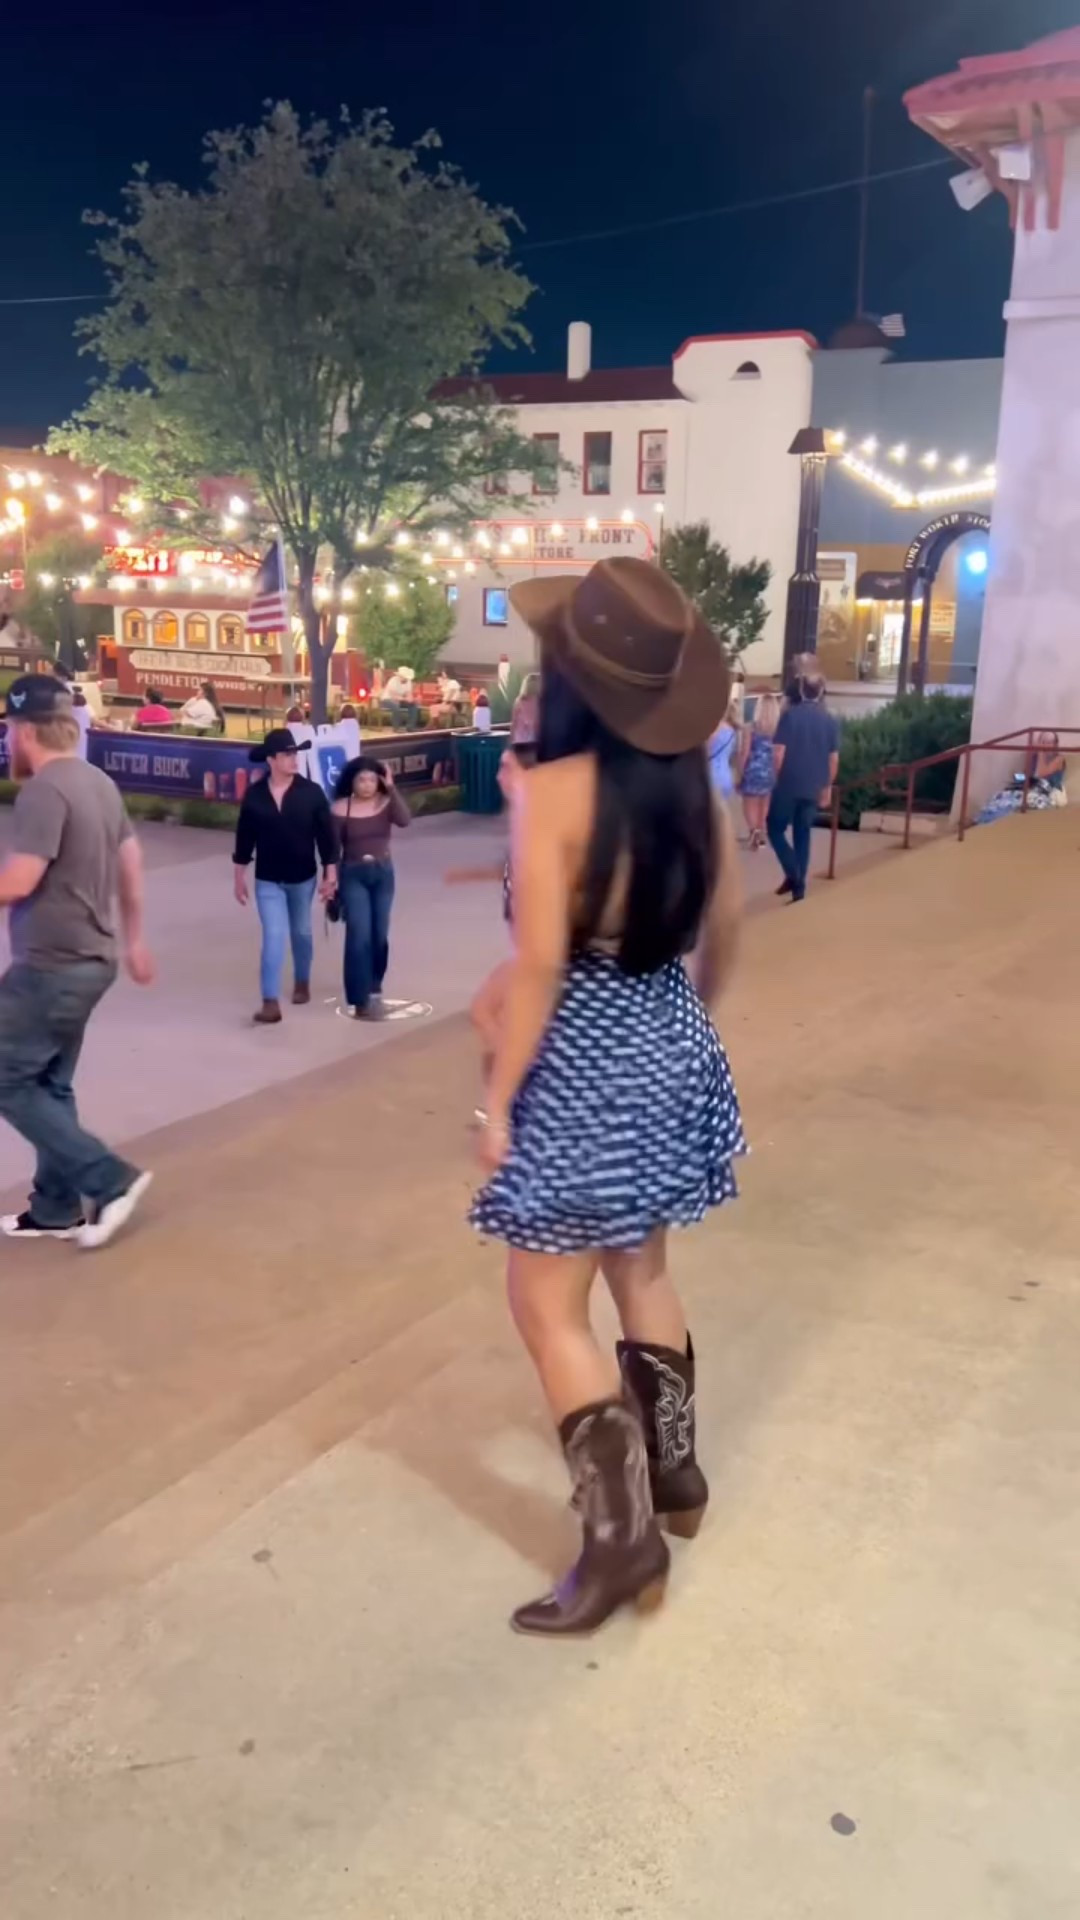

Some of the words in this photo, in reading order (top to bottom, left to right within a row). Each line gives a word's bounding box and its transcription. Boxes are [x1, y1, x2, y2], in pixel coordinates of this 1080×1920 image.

[577, 527, 636, 545] FRONT
[919, 512, 960, 539] WORTH
[153, 755, 191, 779] BUCK
